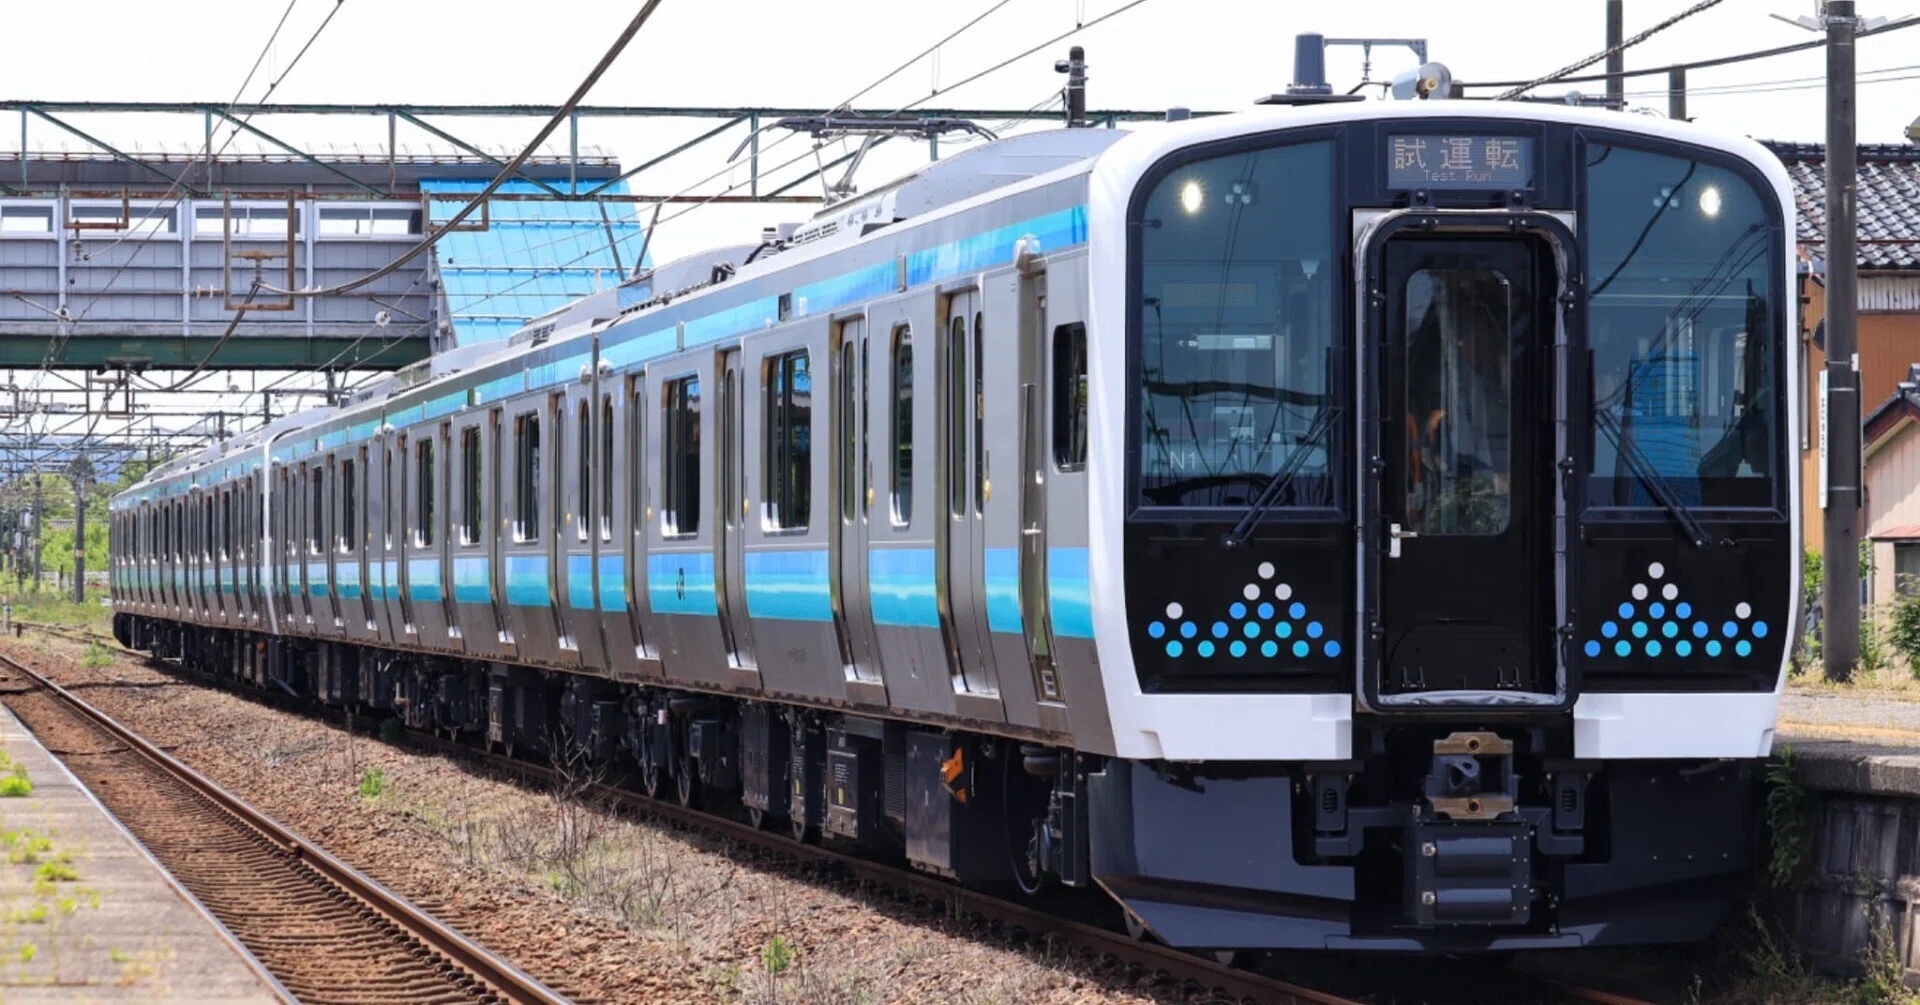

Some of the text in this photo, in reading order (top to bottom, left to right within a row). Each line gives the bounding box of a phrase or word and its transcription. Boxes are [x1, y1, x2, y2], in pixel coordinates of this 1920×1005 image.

[1394, 137, 1519, 170] 試運転
[1423, 169, 1492, 182] Test Run
[1169, 450, 1195, 471] N1
